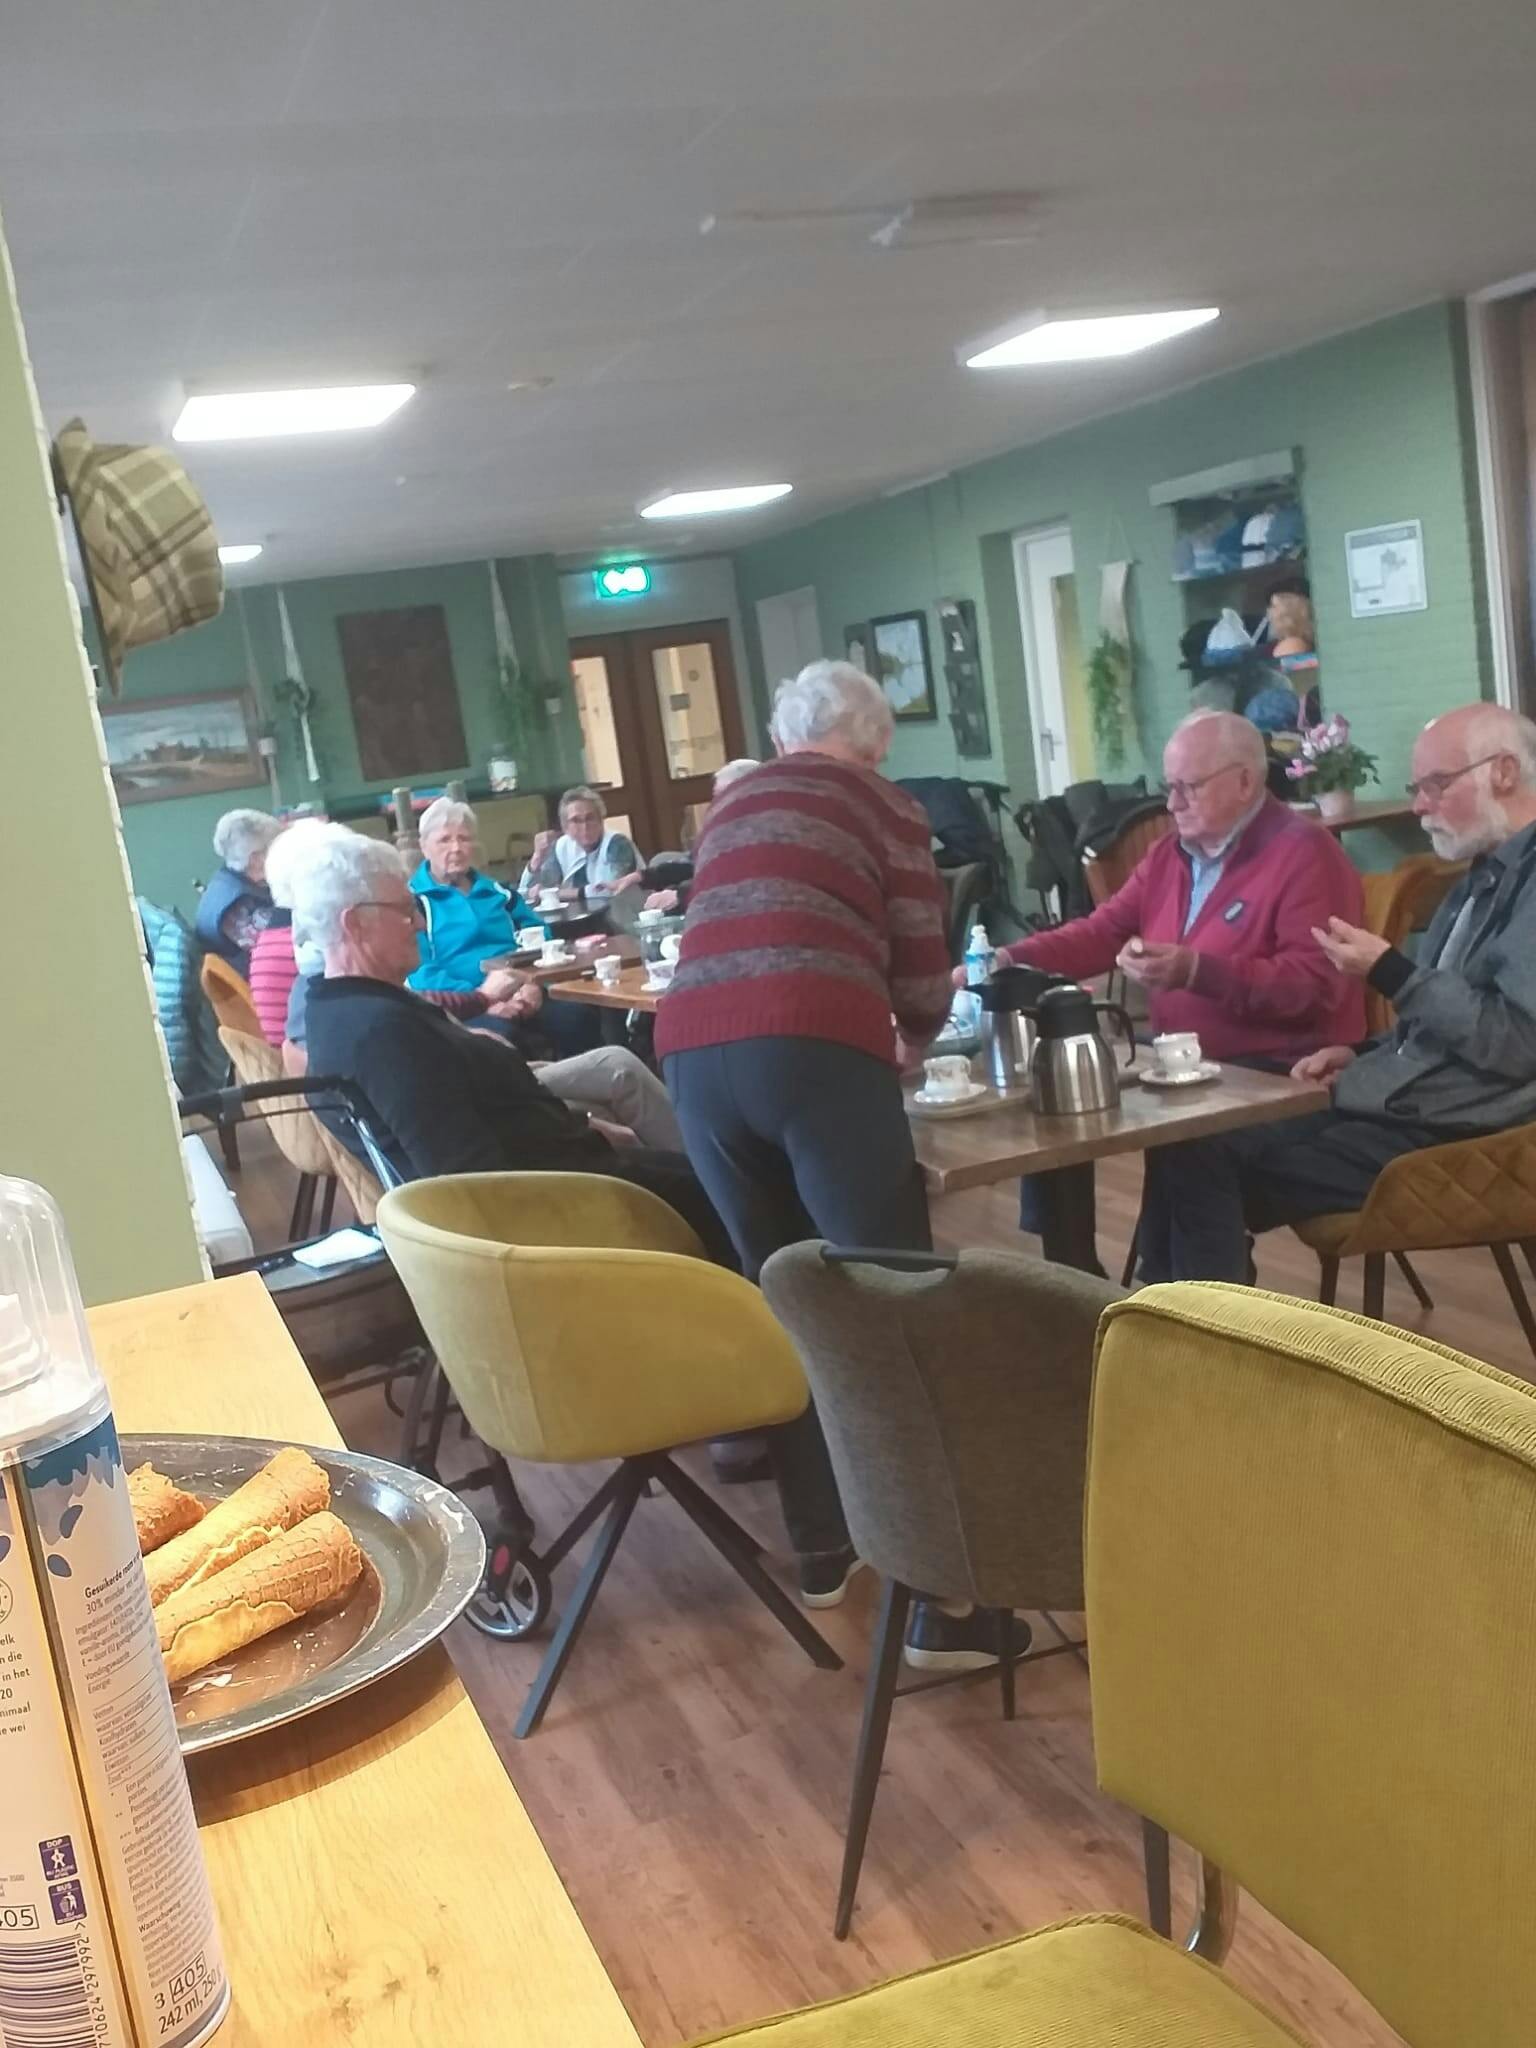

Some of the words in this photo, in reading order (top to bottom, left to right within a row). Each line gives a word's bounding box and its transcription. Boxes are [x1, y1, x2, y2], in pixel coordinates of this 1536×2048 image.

[85, 1569, 122, 1598] Gesuikerde
[8, 1651, 22, 1662] die
[2, 1673, 11, 1681] in
[13, 1668, 30, 1679] het
[9, 1721, 26, 1733] wei
[46, 1839, 62, 1849] DOP
[77, 1936, 99, 1990] 297992
[154, 1992, 166, 2010] 3
[172, 1957, 204, 1997] 405
[158, 2005, 184, 2034] 242
[184, 1989, 203, 2014] ml,
